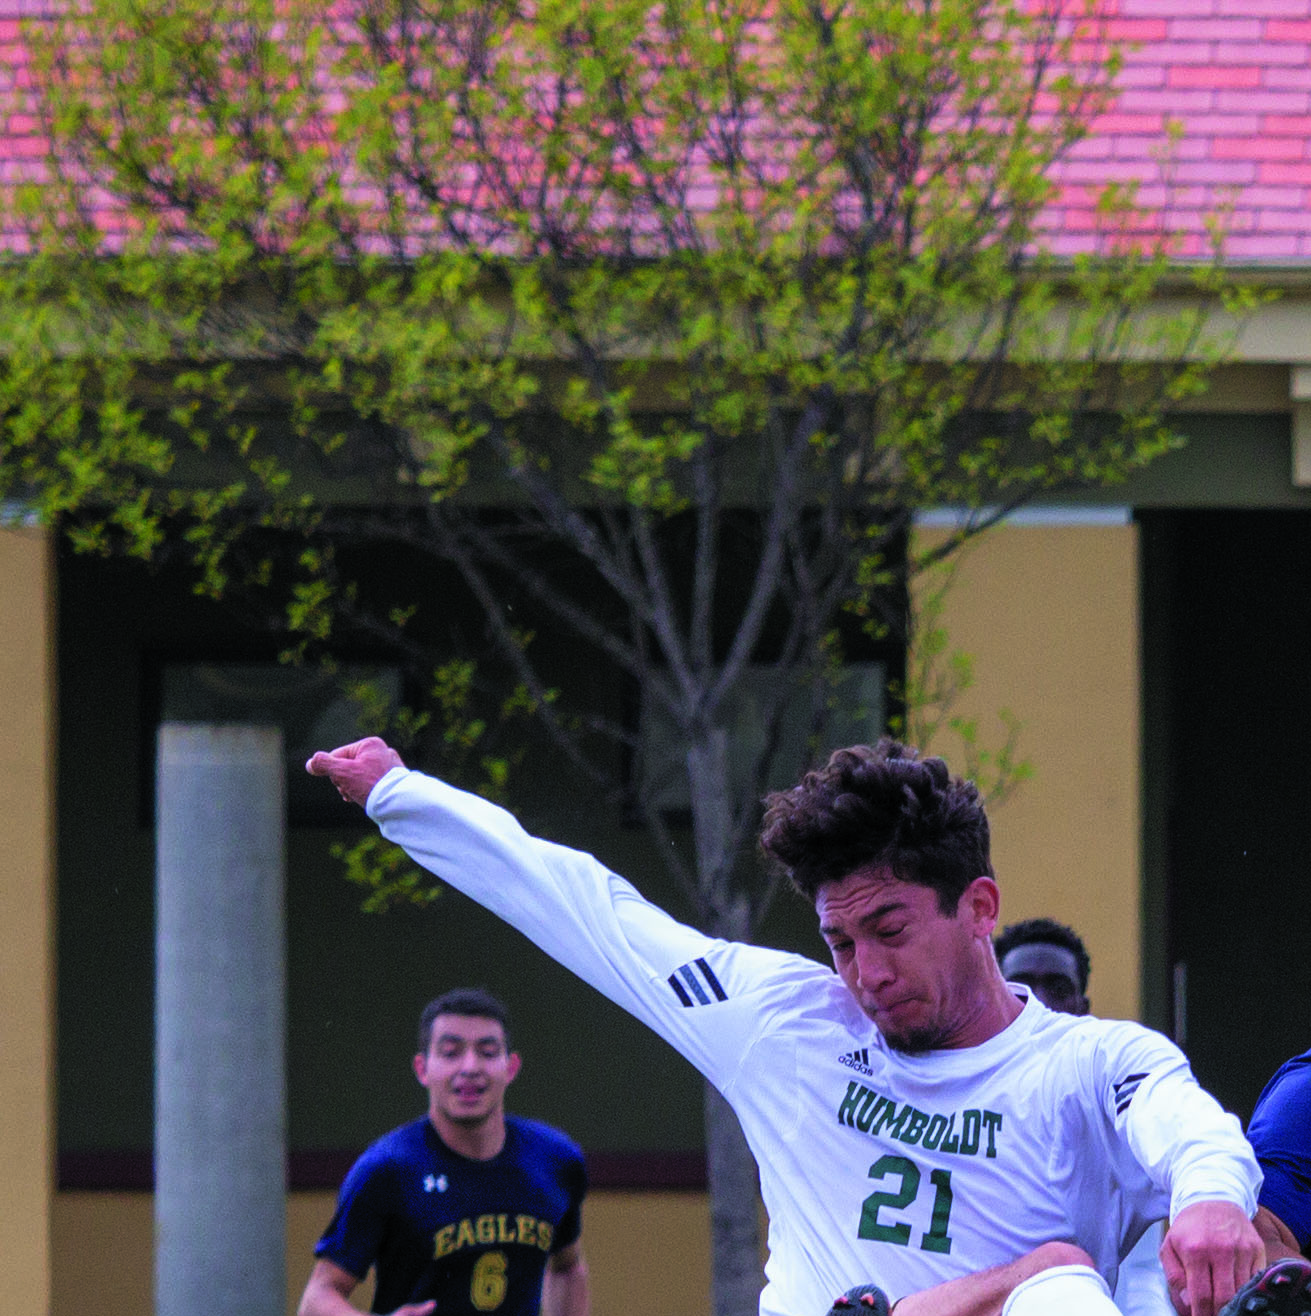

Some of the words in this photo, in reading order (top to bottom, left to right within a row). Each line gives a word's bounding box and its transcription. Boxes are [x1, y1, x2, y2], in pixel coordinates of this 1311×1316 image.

[838, 1056, 874, 1077] adidas
[838, 1080, 1003, 1158] HUMBOLDT
[857, 1154, 953, 1254] 21
[434, 1214, 553, 1259] EAGLES
[470, 1250, 508, 1311] 6
